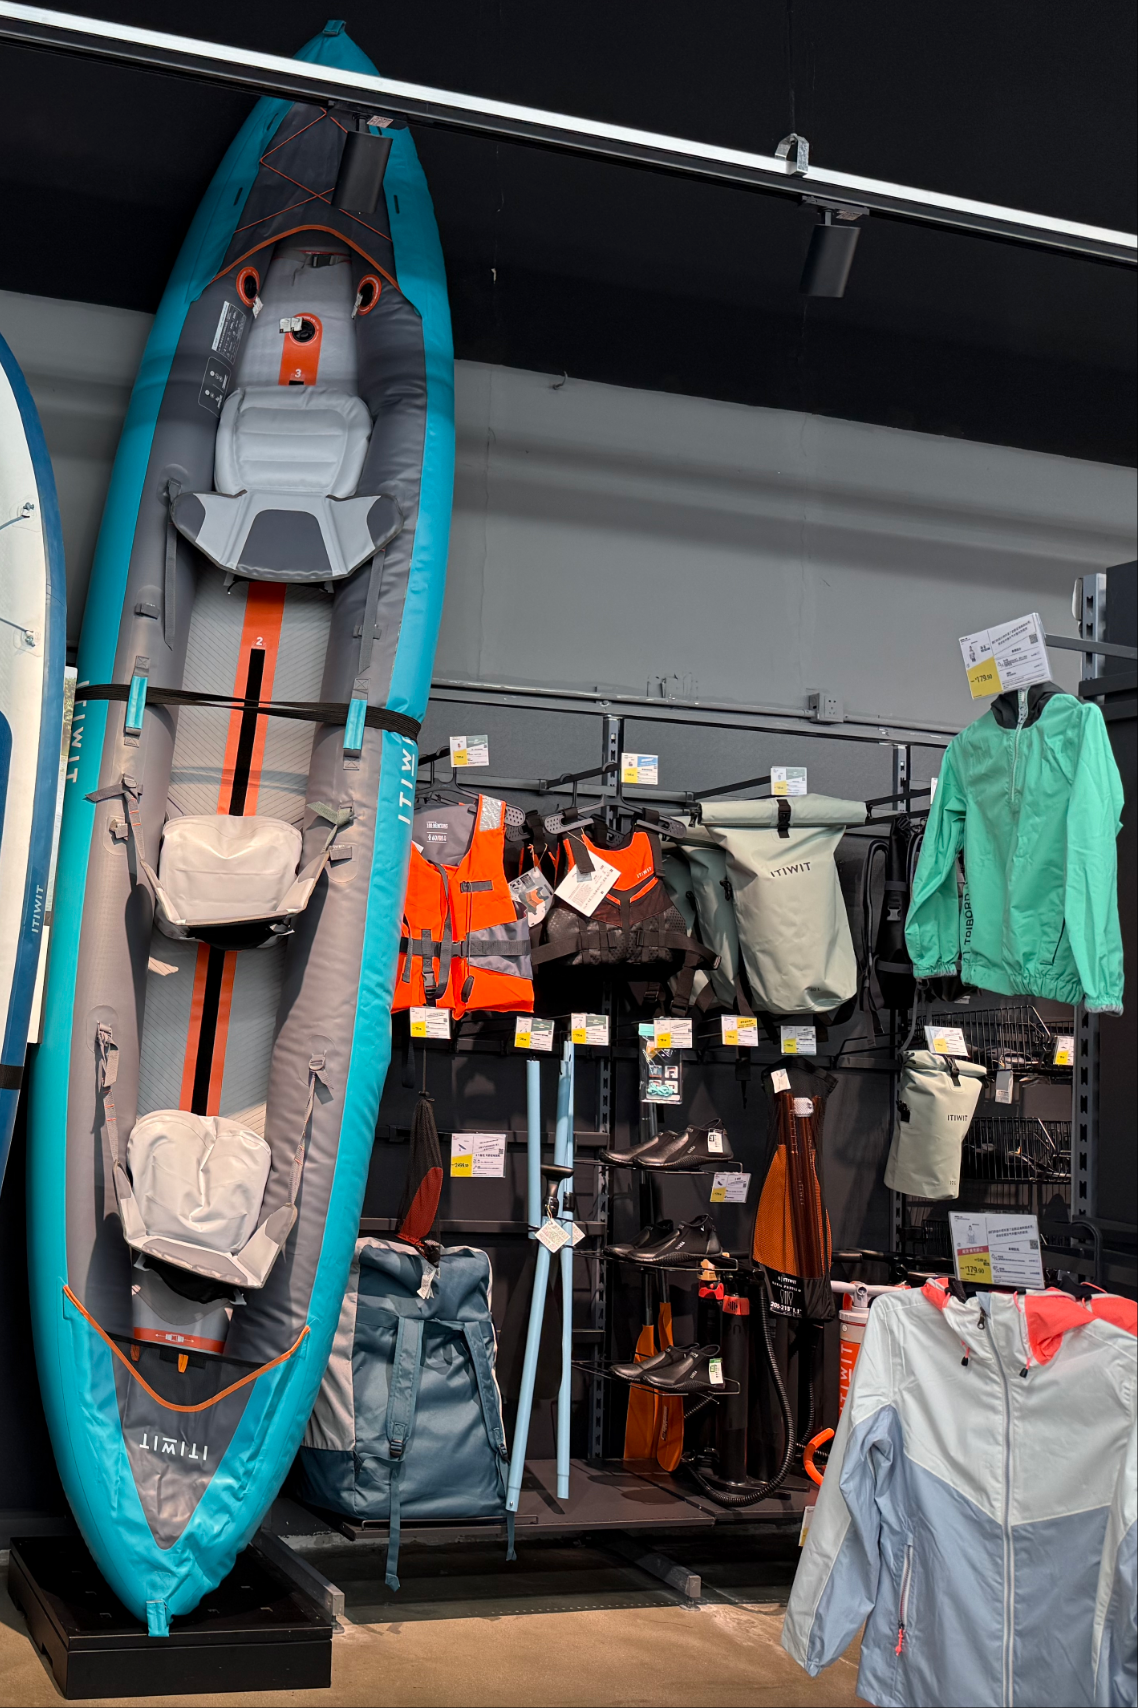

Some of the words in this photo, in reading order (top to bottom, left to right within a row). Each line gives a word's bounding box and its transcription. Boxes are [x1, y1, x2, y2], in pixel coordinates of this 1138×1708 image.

[295, 369, 302, 378] 3
[255, 637, 263, 646] 2
[770, 862, 812, 878] ITIWIT
[31, 884, 44, 934] ITIWIT
[947, 1114, 969, 1122] ITIWIT
[139, 1433, 208, 1461] ITIWIT
